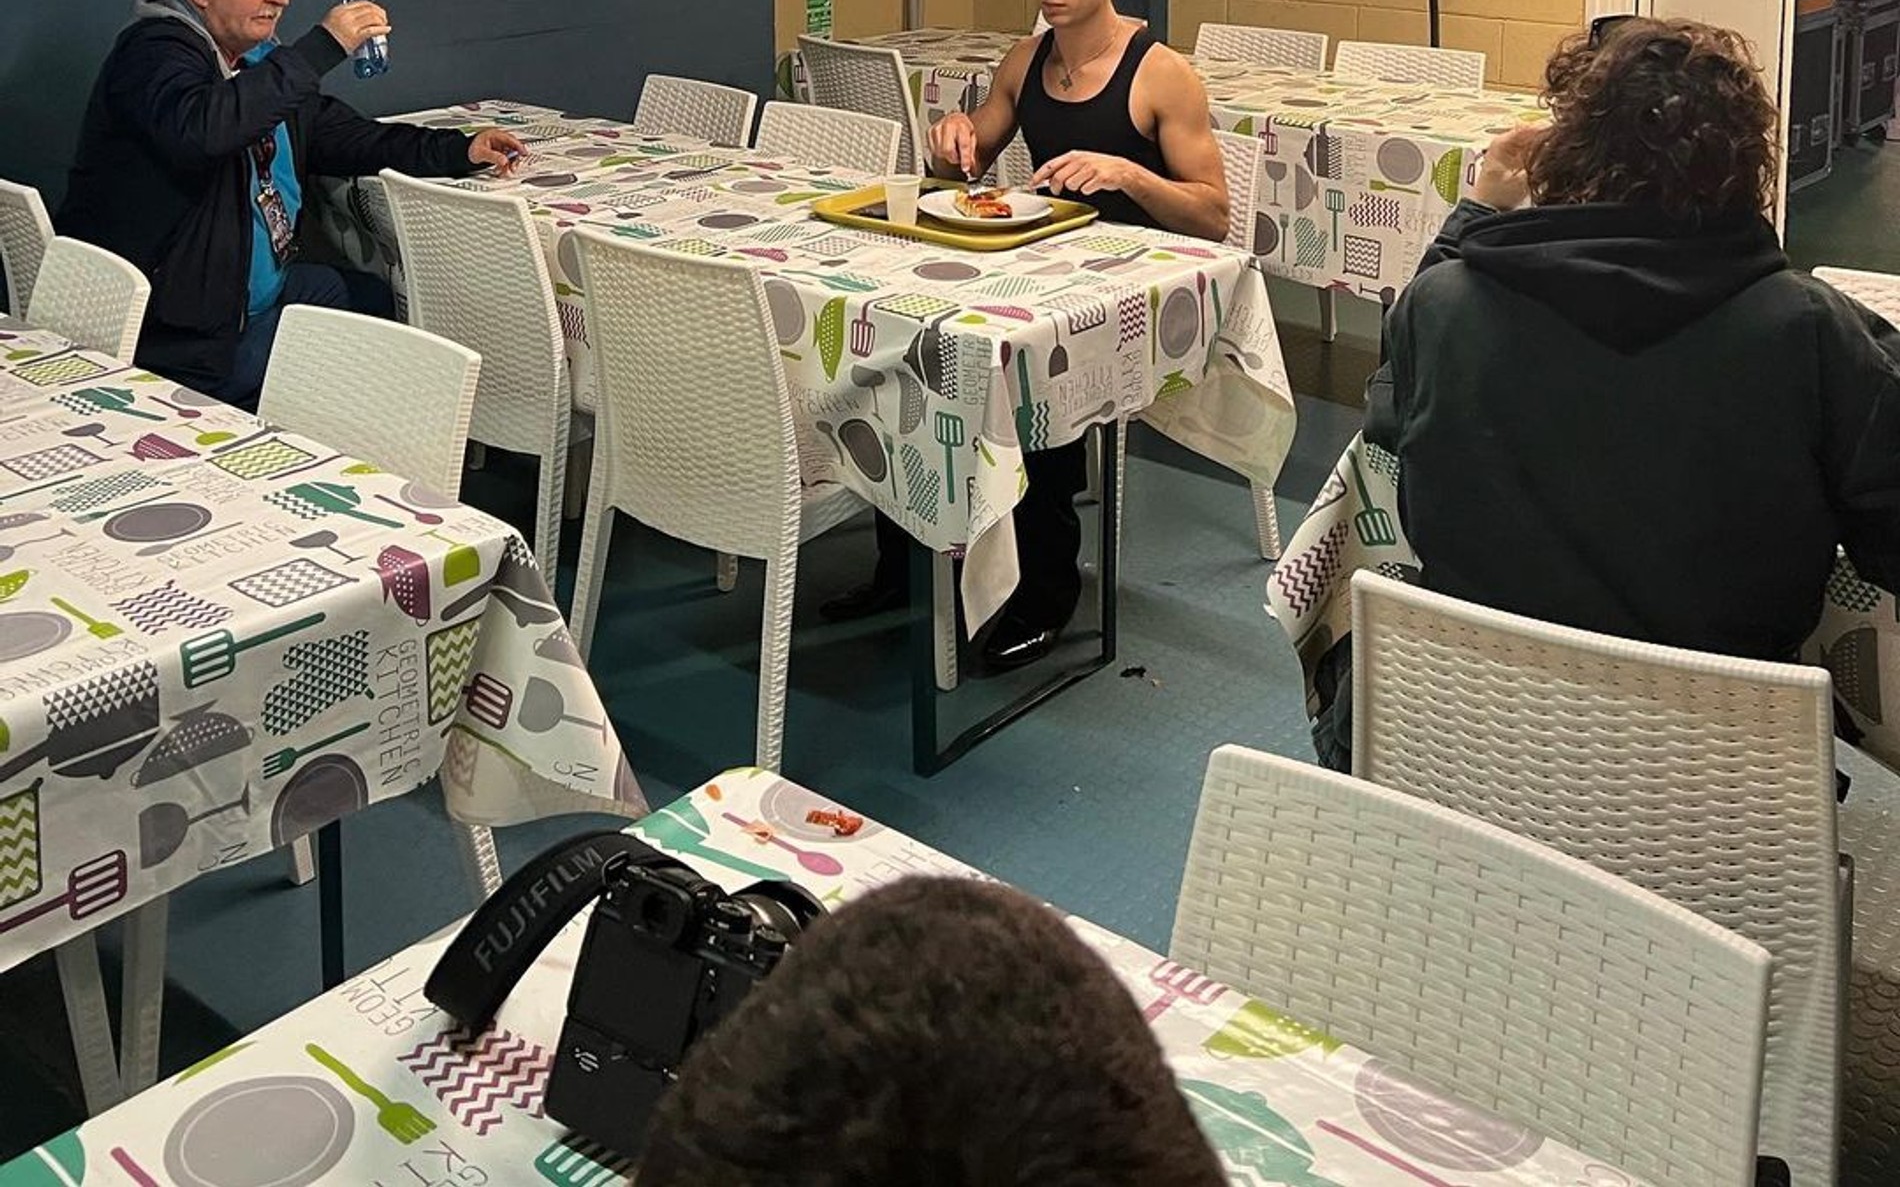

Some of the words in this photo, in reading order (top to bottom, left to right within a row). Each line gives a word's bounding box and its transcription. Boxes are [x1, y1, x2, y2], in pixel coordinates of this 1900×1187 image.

[962, 339, 978, 406] GEOMETR
[376, 645, 402, 786] KITCHEN
[400, 639, 421, 774] GEOMETRIC
[473, 846, 604, 973] FUJIFILM
[341, 979, 415, 1037] GEOM
